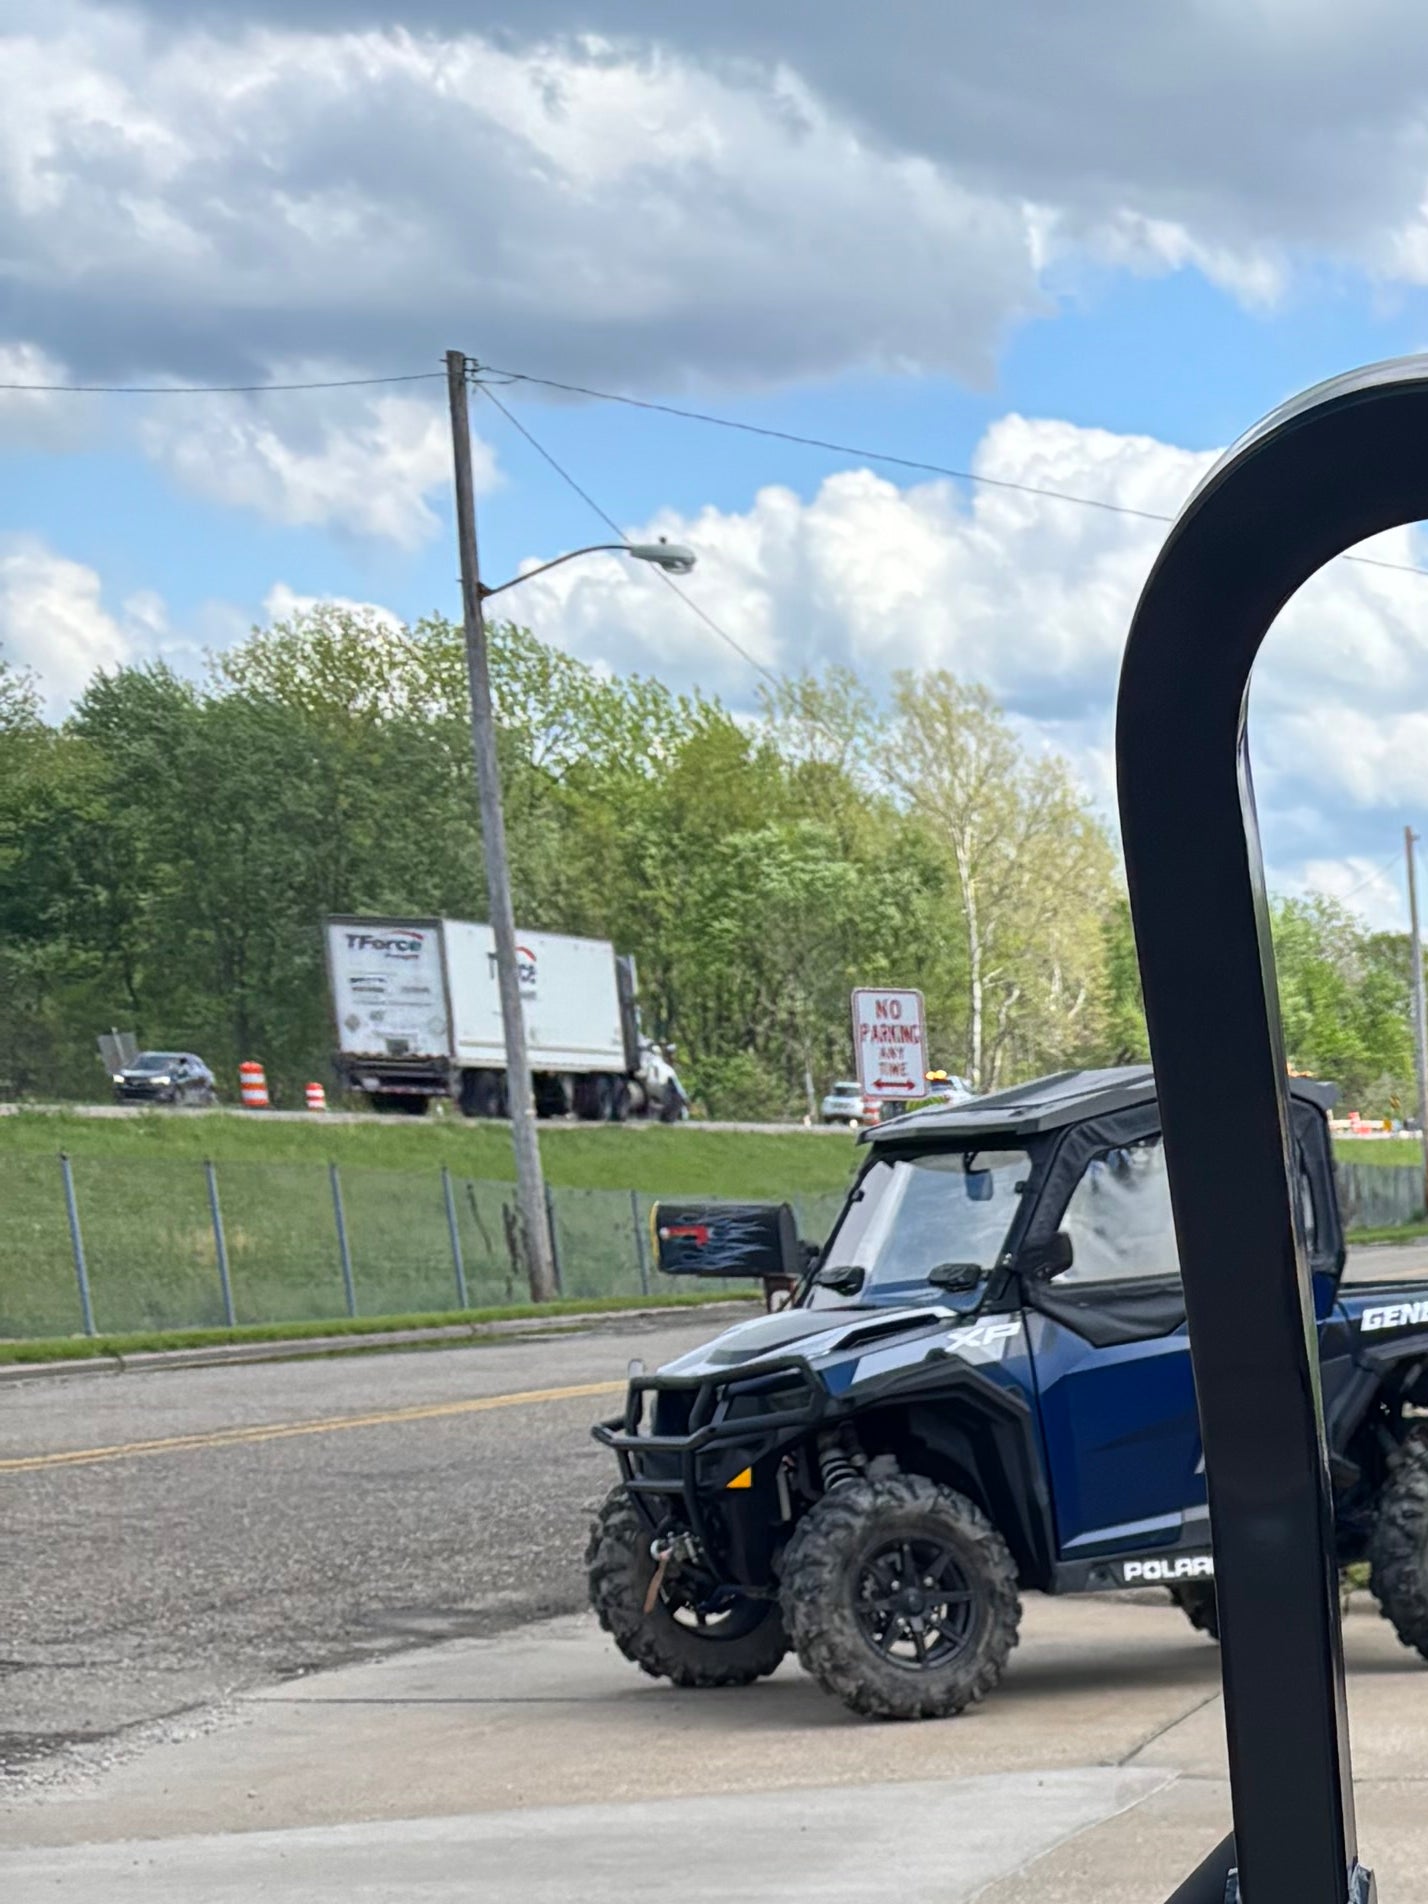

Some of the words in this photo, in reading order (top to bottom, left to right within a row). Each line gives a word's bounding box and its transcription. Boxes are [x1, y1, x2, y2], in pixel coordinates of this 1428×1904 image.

[345, 933, 422, 951] TForce
[875, 999, 902, 1020] NO
[860, 1023, 920, 1044] PARKING
[944, 1321, 1022, 1353] XP
[1123, 1556, 1214, 1582] POLAR
